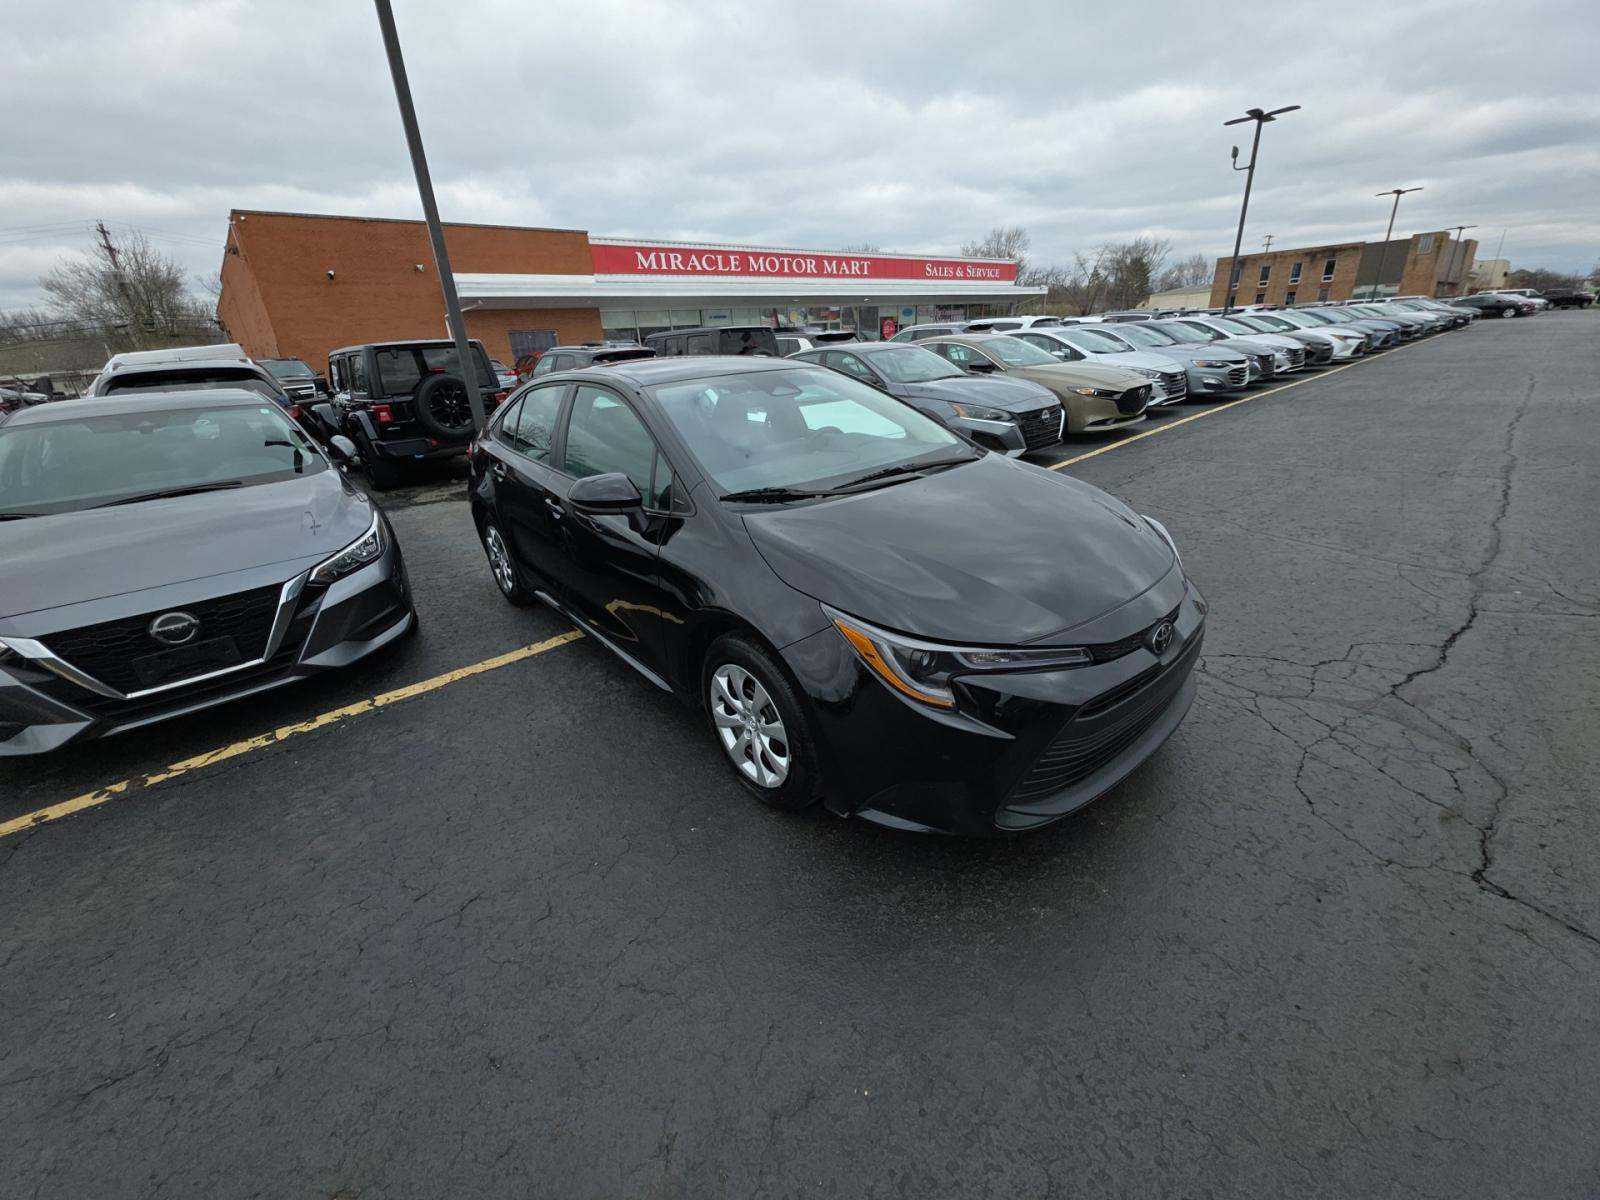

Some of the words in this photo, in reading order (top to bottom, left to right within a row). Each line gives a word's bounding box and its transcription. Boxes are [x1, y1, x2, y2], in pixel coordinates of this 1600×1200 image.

[635, 251, 741, 271] MIRACLE
[748, 255, 817, 274] MOTOR
[823, 260, 871, 275] MART
[925, 264, 953, 277] SALES
[956, 266, 964, 277] &
[966, 265, 1000, 278] SERVICE
